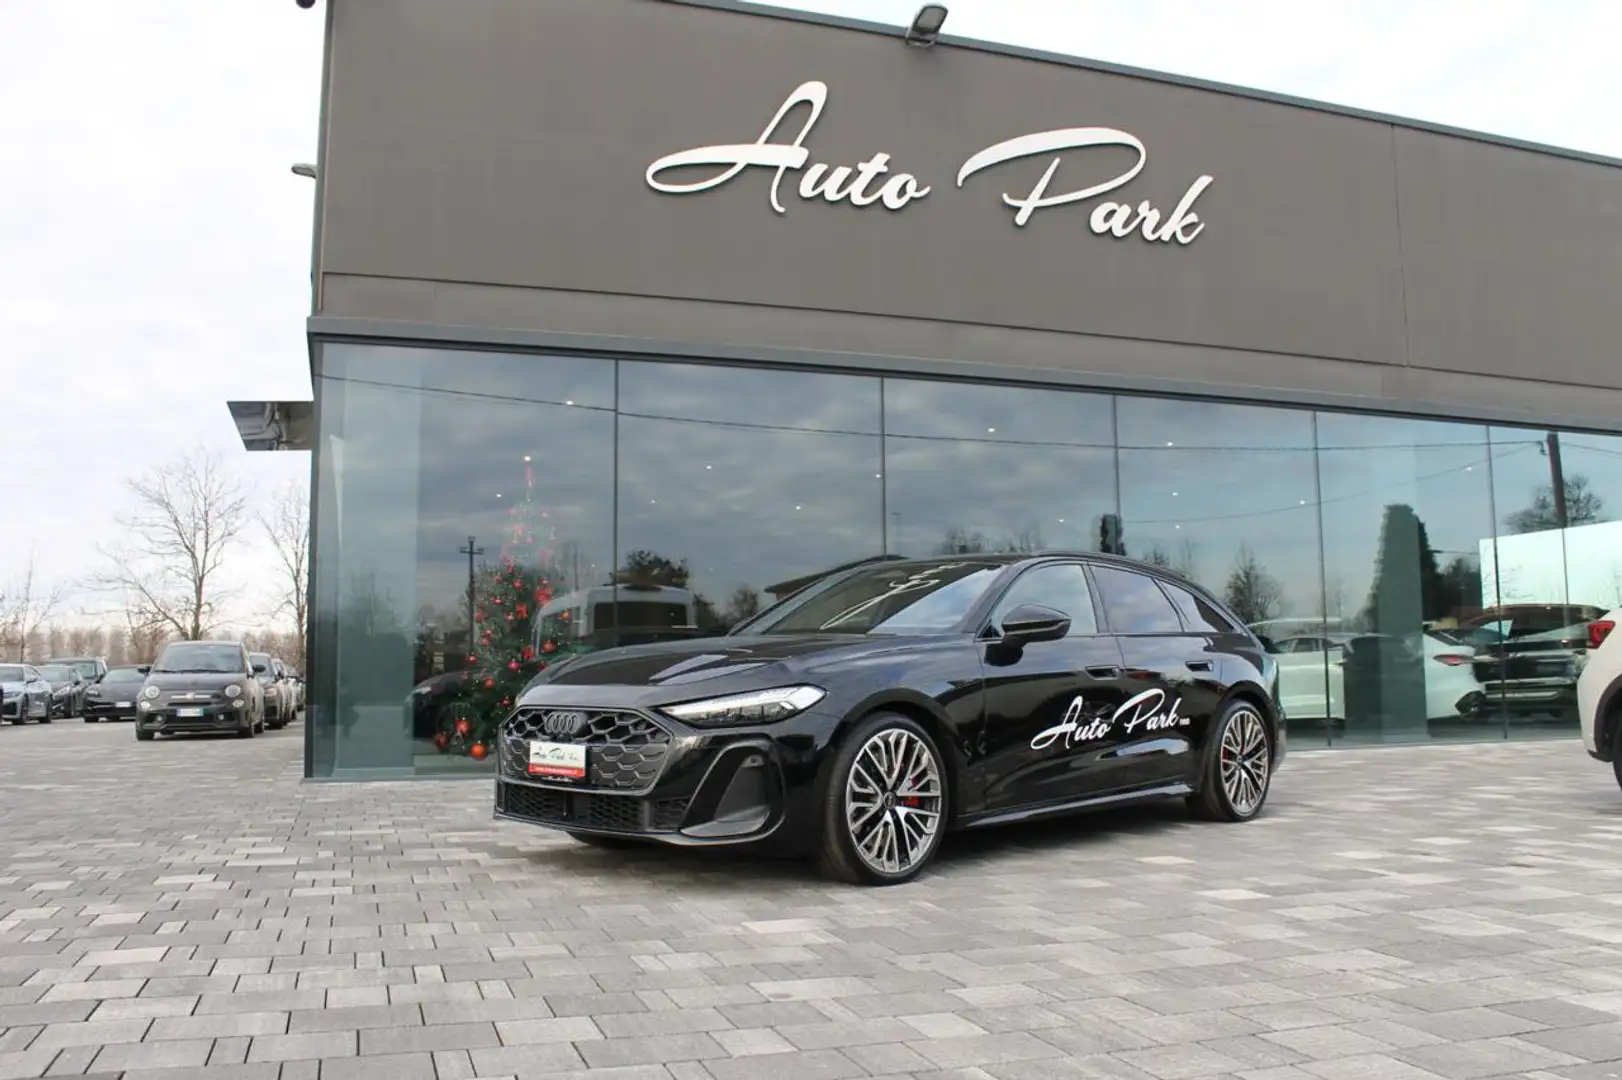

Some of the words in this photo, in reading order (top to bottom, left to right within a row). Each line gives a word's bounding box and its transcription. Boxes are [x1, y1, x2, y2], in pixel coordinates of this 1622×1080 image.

[646, 81, 930, 213] Auto
[957, 127, 1213, 245] Park
[1030, 695, 1110, 750] Auto
[1112, 689, 1182, 734] Park
